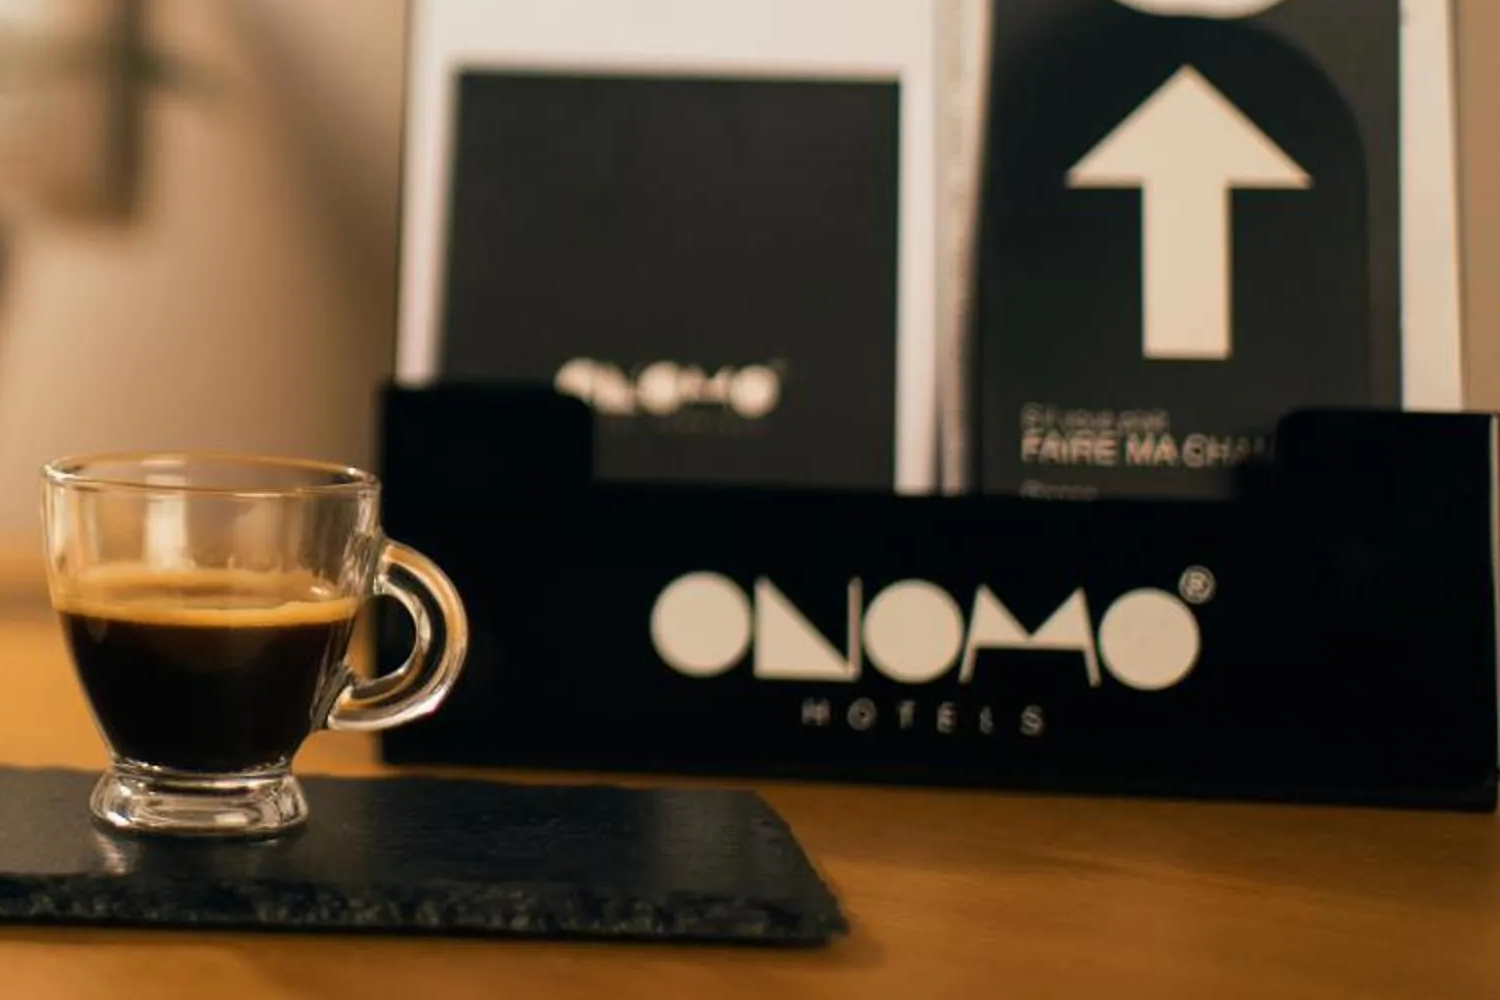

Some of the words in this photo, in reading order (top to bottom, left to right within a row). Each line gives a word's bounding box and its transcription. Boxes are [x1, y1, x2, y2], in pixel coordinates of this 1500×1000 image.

[1021, 431, 1117, 466] FAIRE
[1125, 433, 1178, 467] MA
[801, 698, 1046, 737] HOTELS
